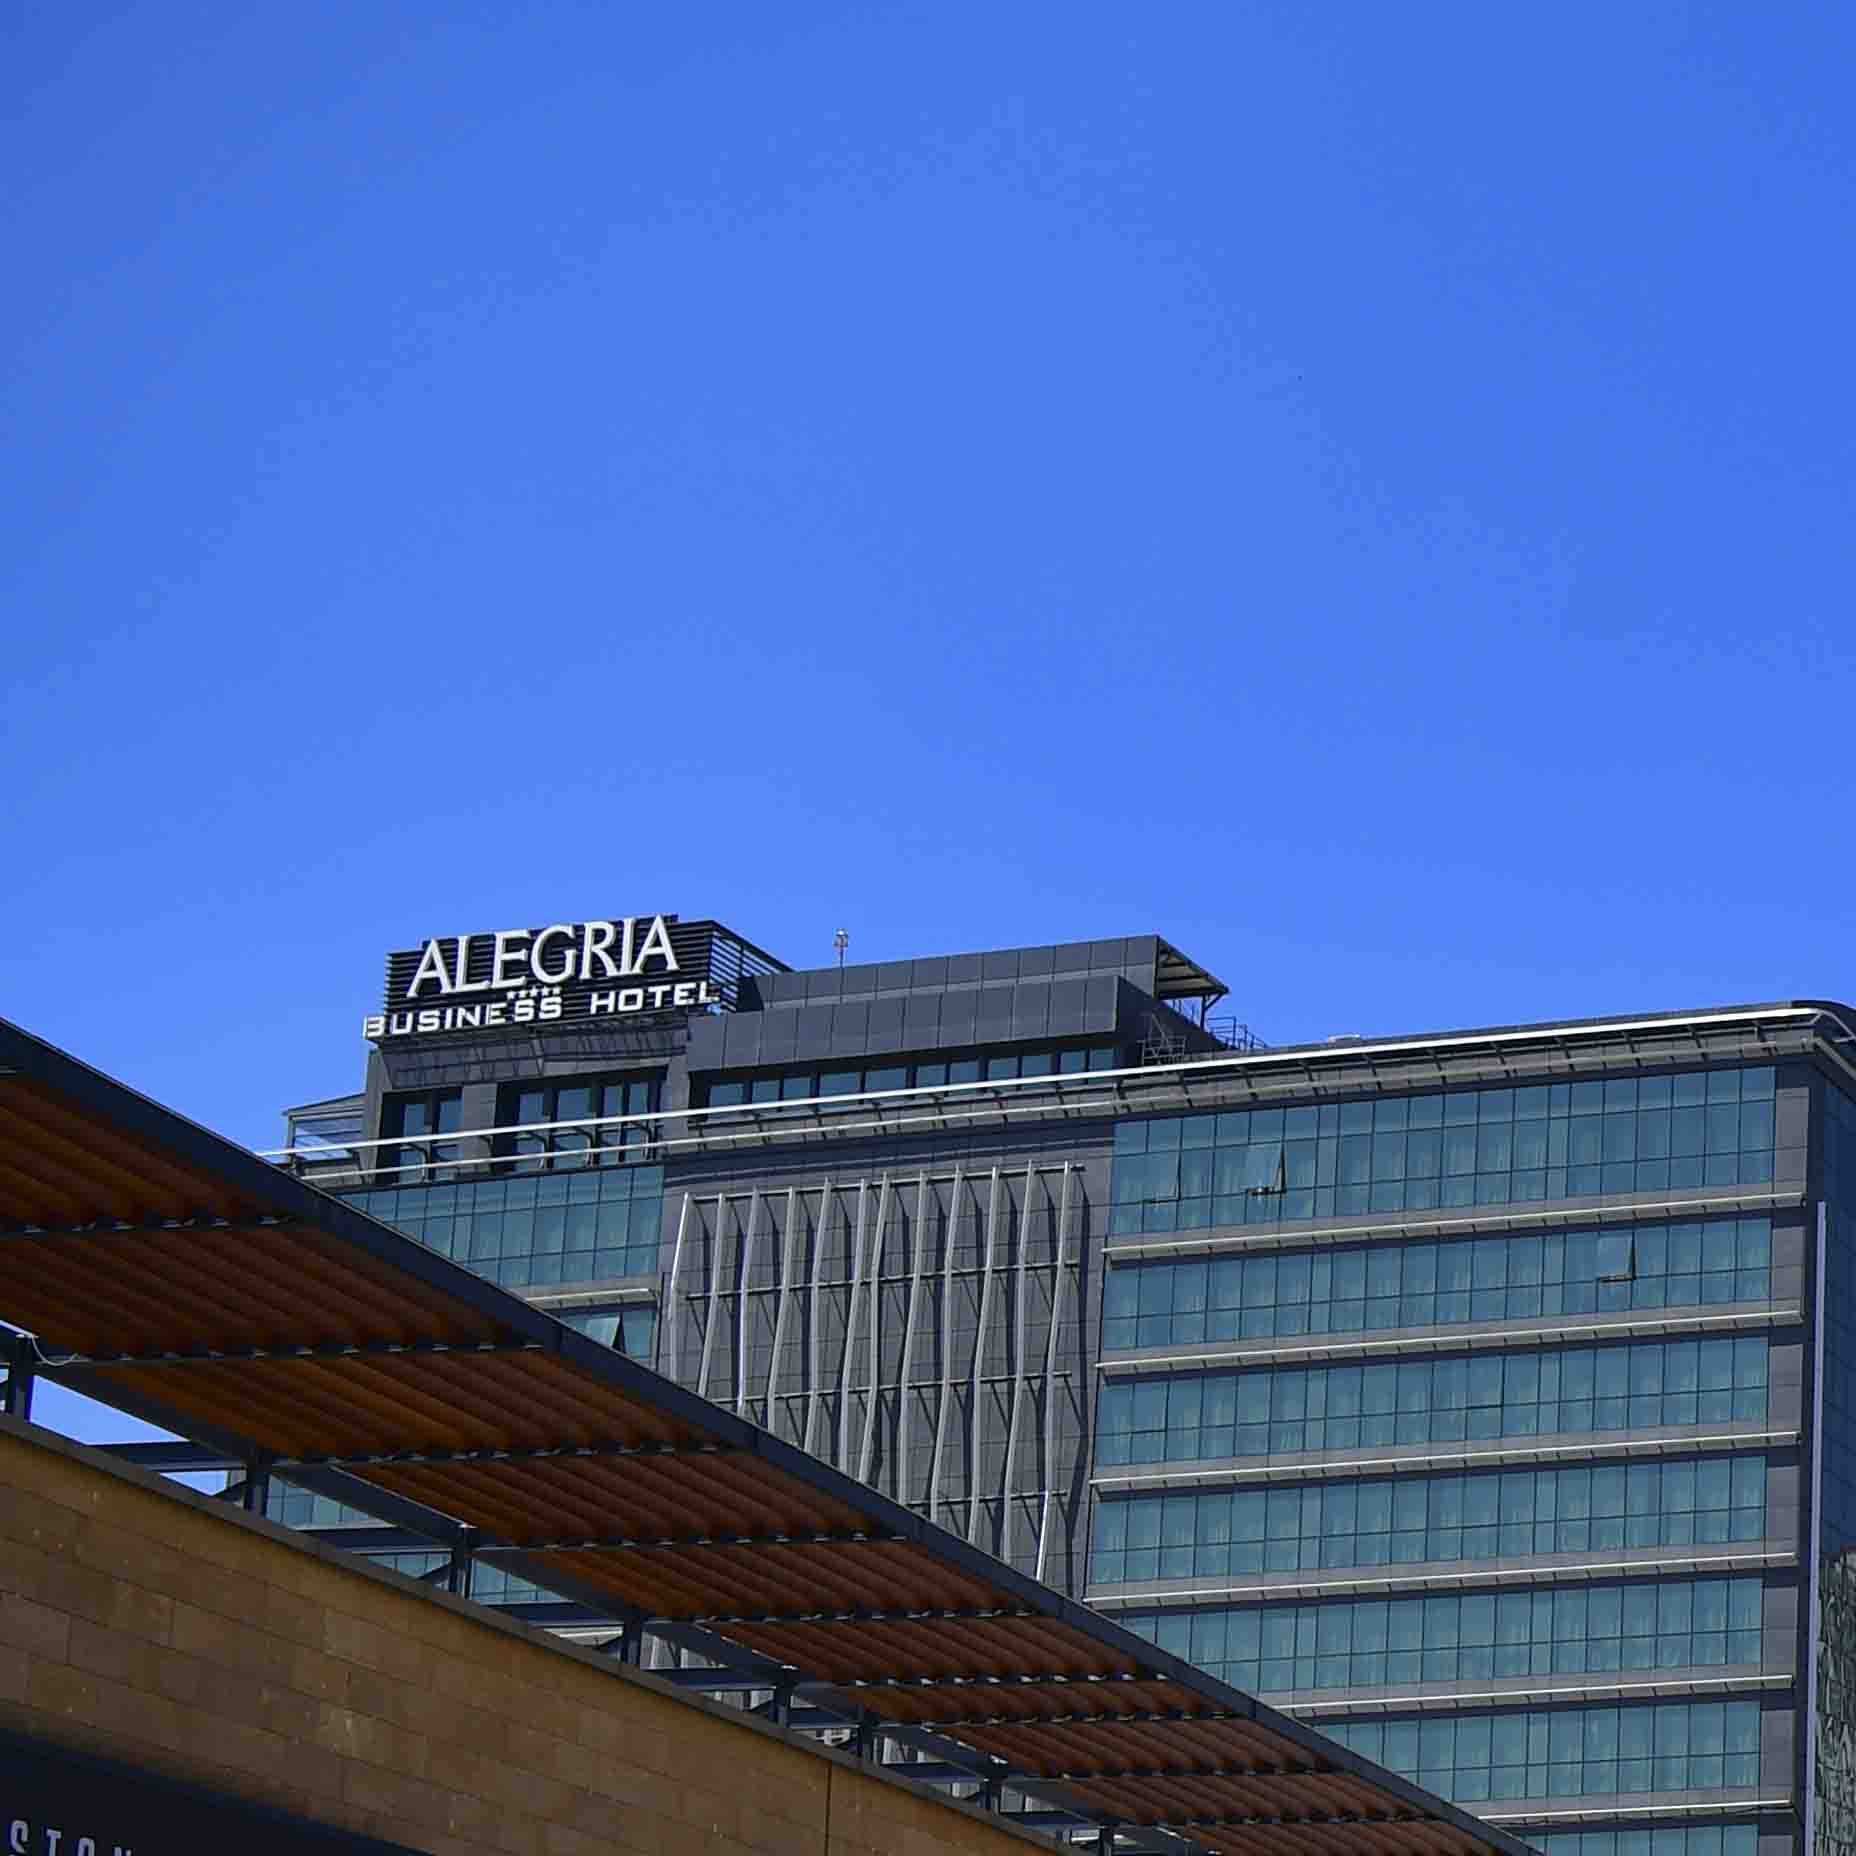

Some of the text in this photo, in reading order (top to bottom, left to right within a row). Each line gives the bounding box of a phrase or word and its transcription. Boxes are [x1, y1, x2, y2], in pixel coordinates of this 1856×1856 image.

[406, 914, 680, 998] ALEGRIA
[362, 981, 720, 1040] BUSINESS HOTEL
